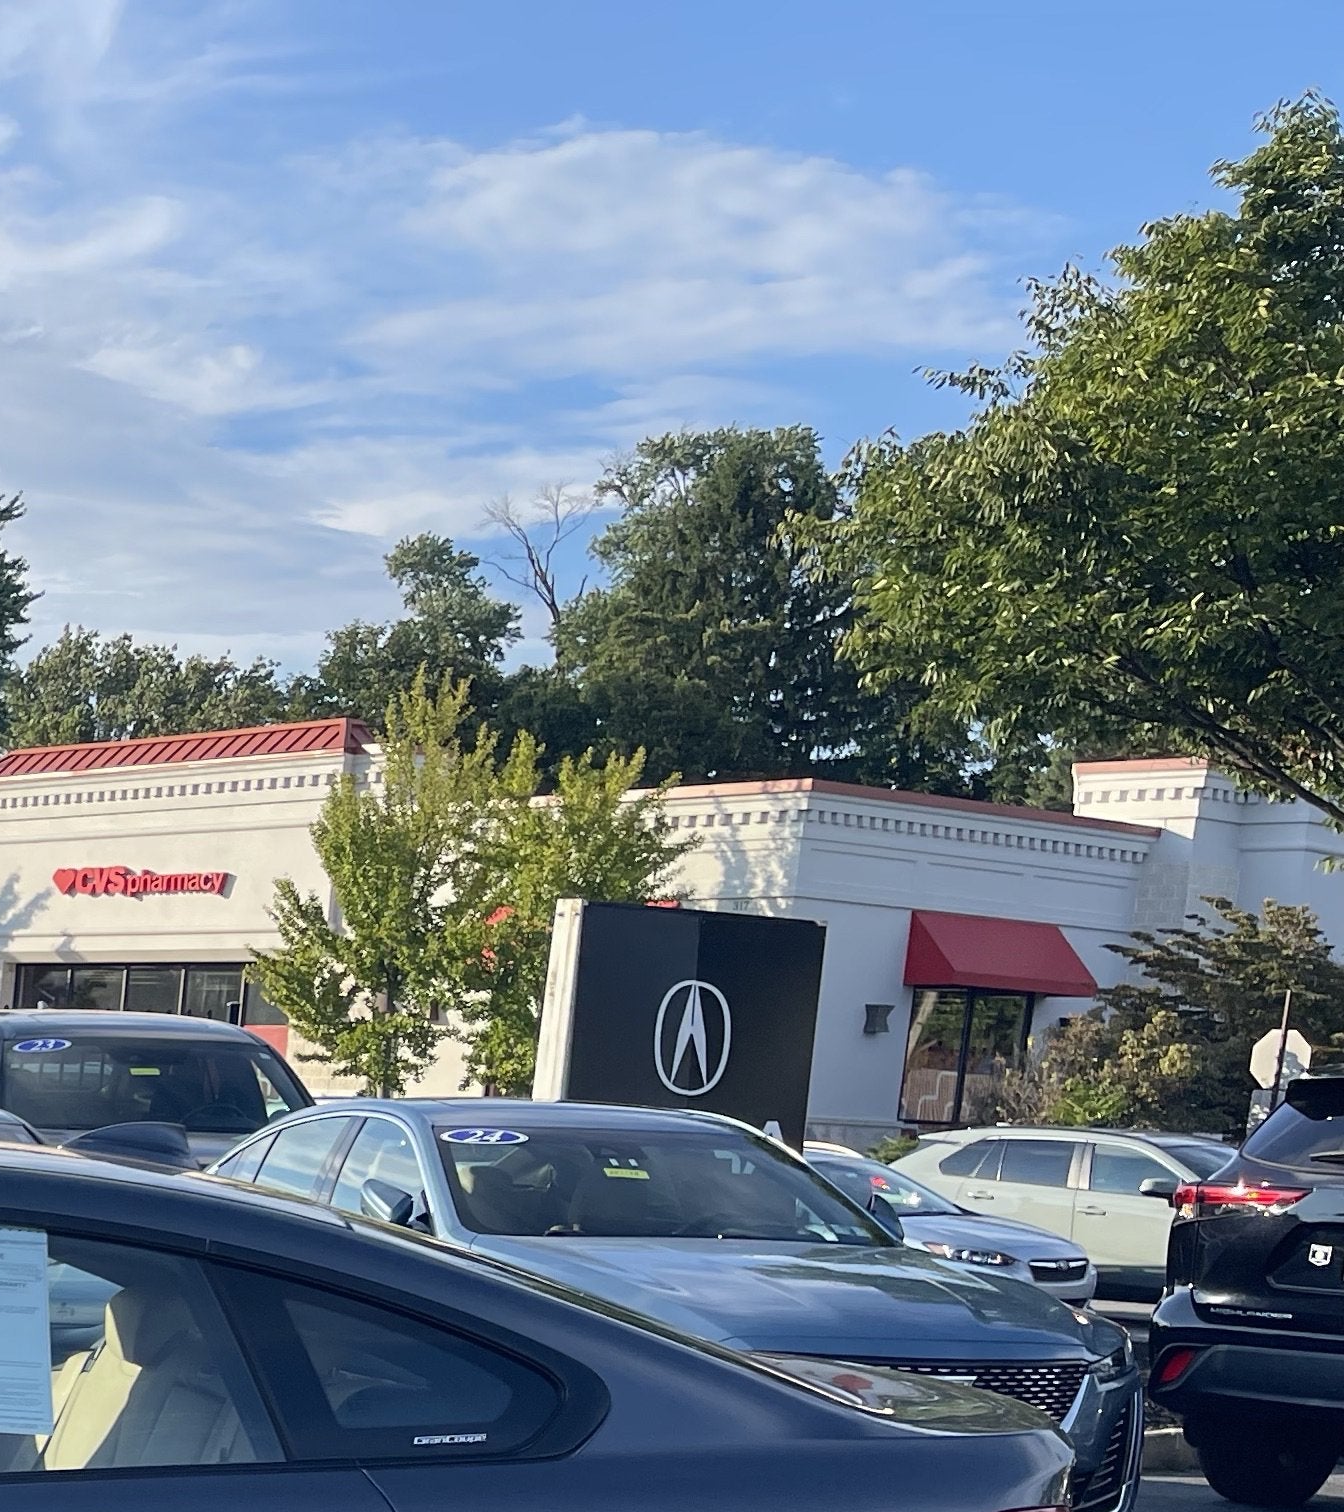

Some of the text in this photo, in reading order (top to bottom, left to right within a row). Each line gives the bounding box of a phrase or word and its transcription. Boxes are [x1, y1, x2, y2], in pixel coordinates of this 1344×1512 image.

[74, 866, 225, 897] CVS pharmacy
[30, 1039, 57, 1052] 23
[464, 1129, 502, 1143] 24
